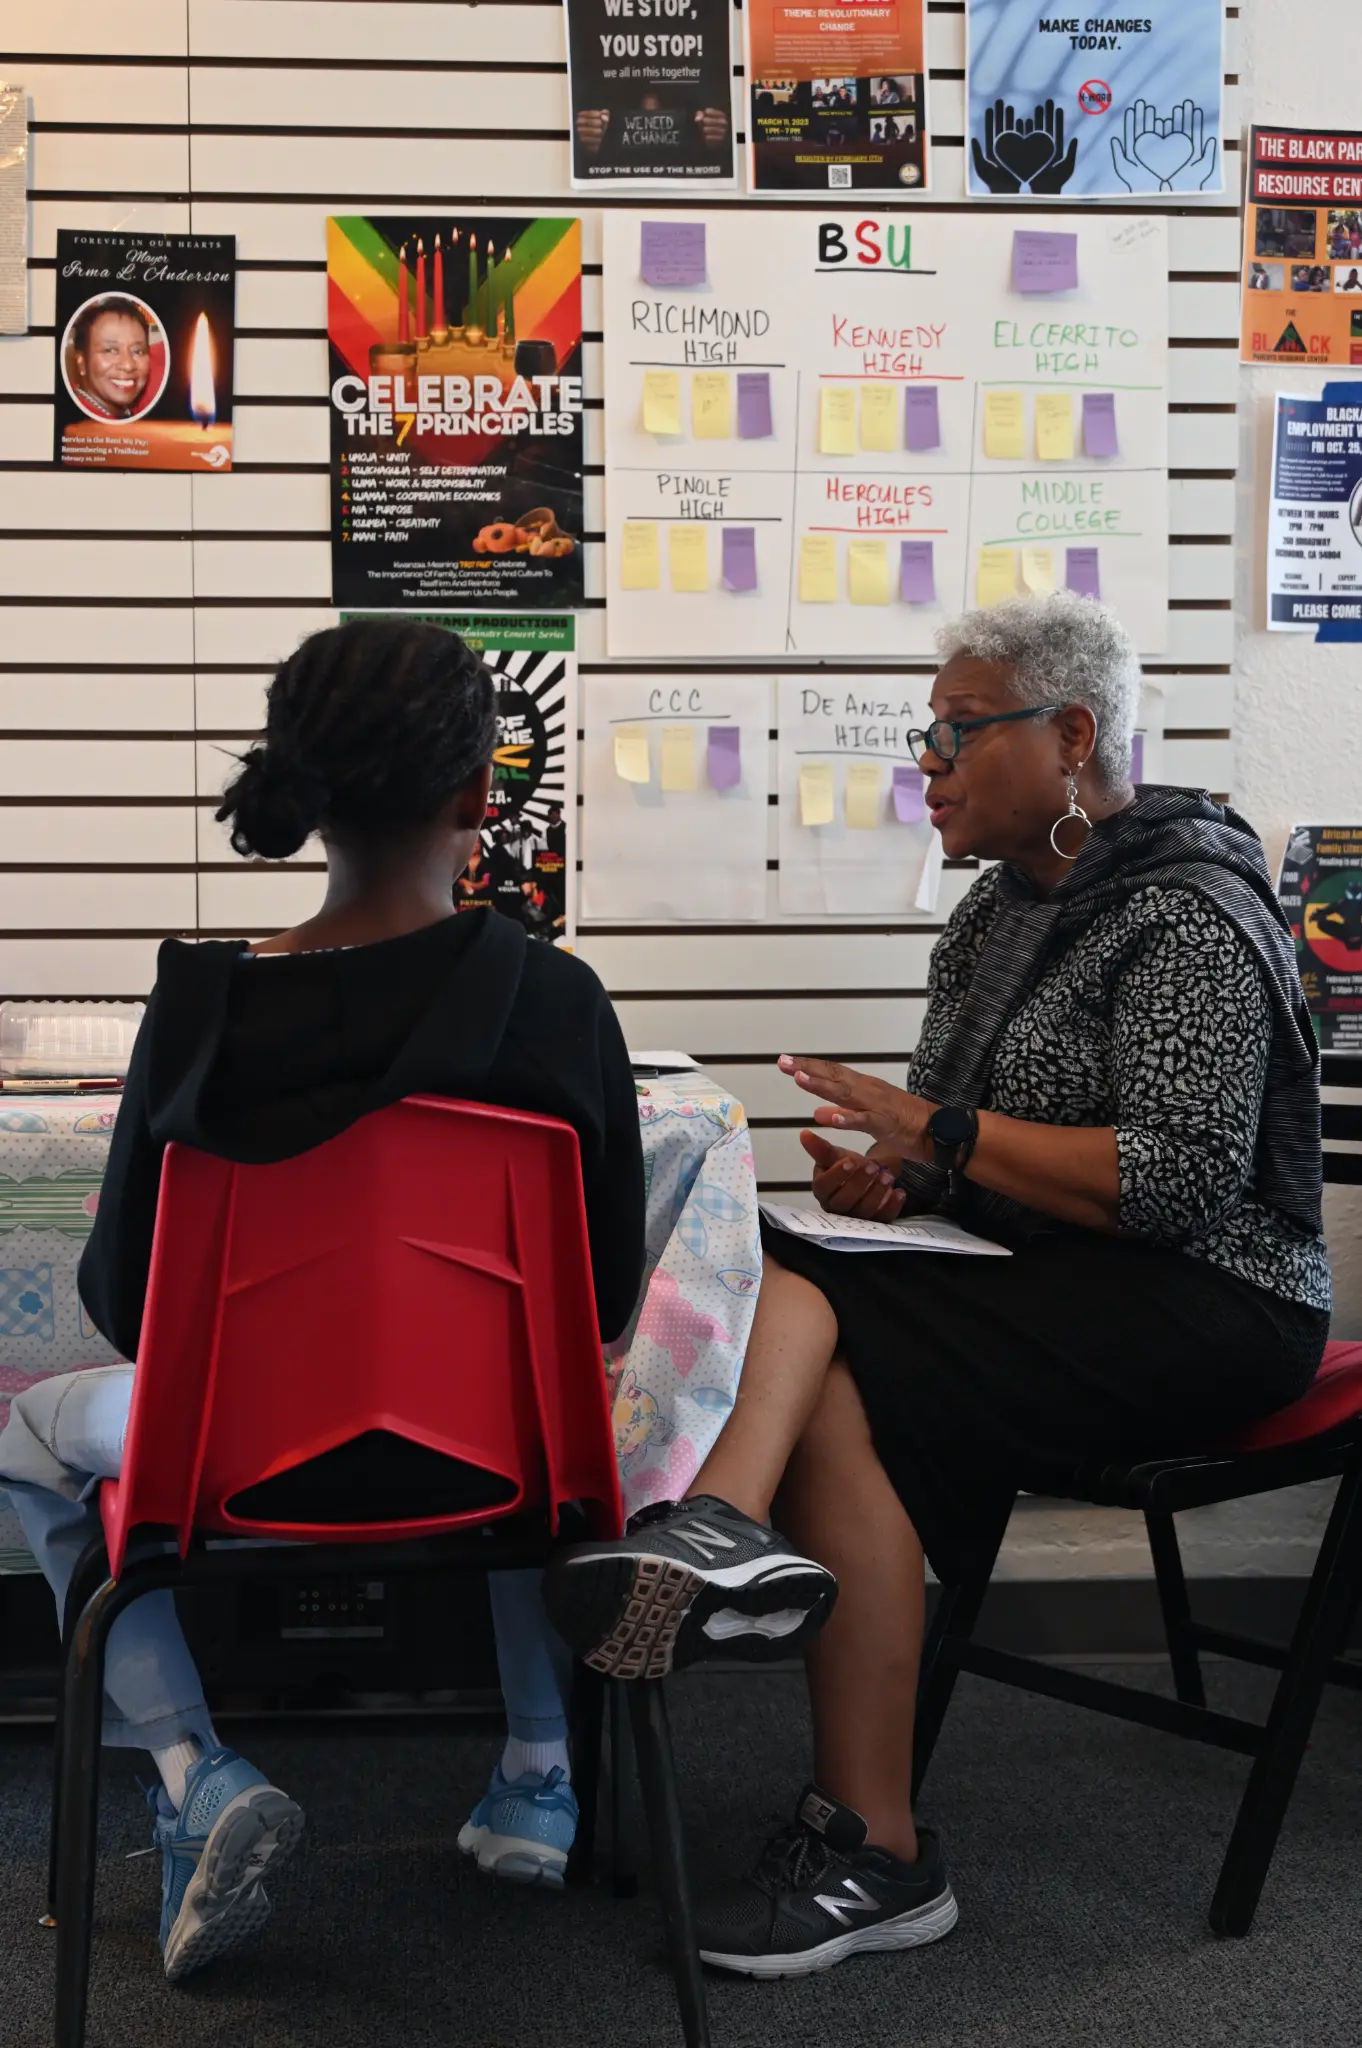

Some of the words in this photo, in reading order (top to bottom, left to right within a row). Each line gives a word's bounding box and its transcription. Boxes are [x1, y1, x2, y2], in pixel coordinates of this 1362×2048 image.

[603, 0, 634, 17] WE
[638, 0, 697, 20] STOP,
[784, 8, 816, 18] THEME:
[818, 8, 890, 18] REVOLUTIONARY
[820, 22, 855, 31] CHANGE
[1039, 19, 1080, 33] MAKE
[1085, 19, 1151, 33] CHANGES
[599, 34, 640, 57] YOU
[643, 34, 703, 57] STOP!
[1069, 35, 1122, 50] TODAY.
[603, 69, 617, 78] we
[619, 66, 630, 77] all
[632, 66, 640, 77] in
[642, 66, 660, 77] this
[662, 65, 700, 79] together
[624, 116, 642, 130] WE
[644, 116, 674, 130] NEED
[757, 118, 782, 126] MARCH
[622, 131, 631, 145] A
[632, 130, 680, 145] CHANGE
[1260, 137, 1284, 158] THE
[1289, 140, 1334, 160] BLACK
[588, 166, 612, 174] STOP
[614, 166, 630, 174] THE
[633, 166, 650, 174] USE
[652, 166, 664, 174] OF
[666, 166, 683, 174] THE
[1258, 174, 1329, 196] RESOURSE
[1334, 178, 1362, 196] CEN
[74, 236, 125, 246] FOREVER
[150, 240, 172, 248] OUR
[818, 219, 912, 270] BSU
[125, 250, 169, 265] Mayor
[142, 265, 230, 282] Anderson
[632, 300, 770, 339] RICHMOND
[832, 313, 946, 349] KENNEDY
[1030, 322, 1138, 348] CERRITO
[684, 340, 738, 363] HIGH
[862, 352, 923, 375] HIGH
[1036, 352, 1099, 374] HIGH
[332, 374, 583, 412] CELEBRATE
[343, 413, 394, 436] THE
[394, 412, 416, 446] 7
[416, 413, 574, 436] PRINCIPLES
[1288, 421, 1354, 438] EMPLOYMENT
[1312, 441, 1324, 453] FRI
[1327, 442, 1346, 454] OCT.
[386, 453, 410, 462] UNITY
[420, 466, 439, 476] SELF
[441, 466, 507, 476] DETERMINATION
[386, 480, 410, 488] WORK
[412, 480, 420, 488] &
[421, 480, 486, 488] RESPONSIBILITY
[656, 474, 732, 498] PINOLE
[826, 477, 933, 507] HERCULES
[1021, 480, 1104, 505] MIDDLE
[396, 492, 451, 501] COOPERATIVE
[453, 492, 501, 501] ECONOMICS
[351, 505, 367, 514] NIA
[376, 505, 413, 514] PURPOSE
[680, 499, 724, 520] HIGH
[857, 506, 910, 527] HIGH
[396, 518, 441, 528] CREATIVITY
[1016, 510, 1122, 534] COLLEGE
[384, 532, 408, 541] FAITH
[1293, 604, 1328, 618] PLEASE
[1331, 604, 1362, 618] COME
[473, 617, 568, 628] PRODUCTIONS
[503, 630, 536, 638] Concert
[845, 693, 914, 719] ANZA
[498, 728, 535, 745] HE
[834, 724, 898, 748] HIGH
